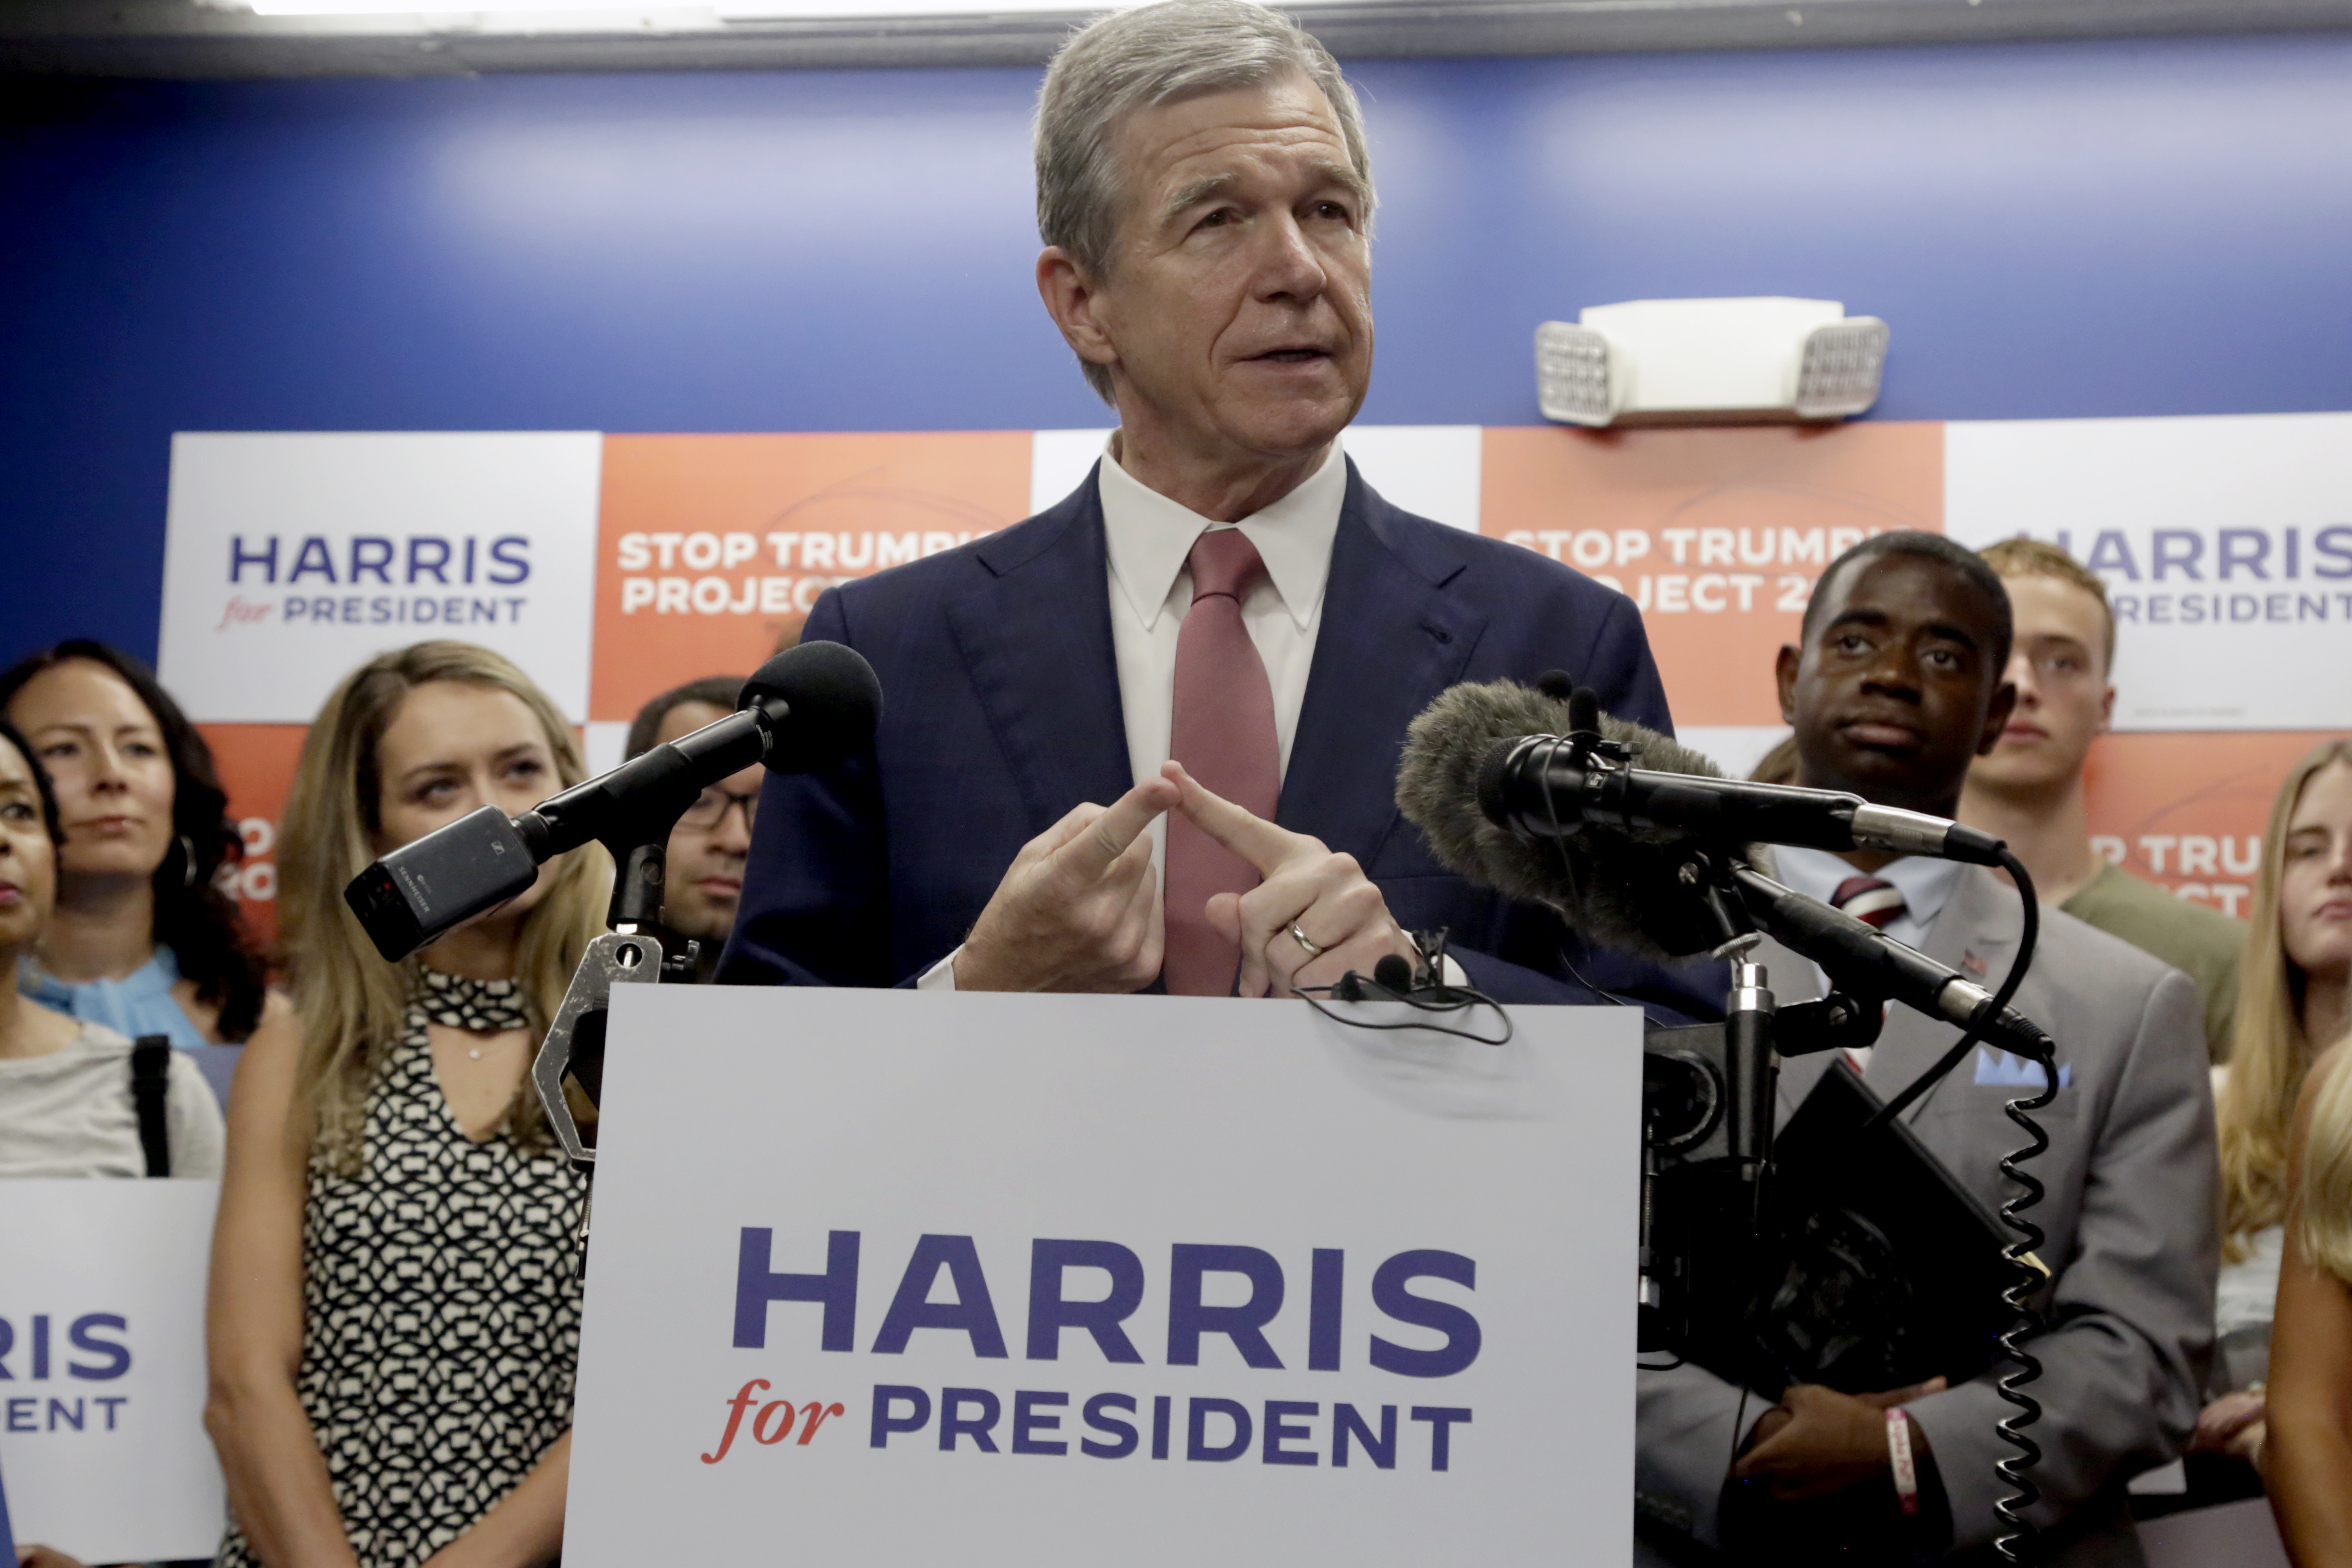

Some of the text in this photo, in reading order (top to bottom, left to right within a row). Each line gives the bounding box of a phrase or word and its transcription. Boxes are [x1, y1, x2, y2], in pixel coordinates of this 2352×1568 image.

[231, 536, 530, 584] HARRIS
[617, 530, 998, 570] STOP TRUMP'
[1662, 527, 1912, 565] TRUMP'
[2017, 527, 2352, 580] ARRIS
[214, 595, 526, 633] for PRESIDENT
[622, 575, 858, 615] PROJEC
[2114, 593, 2352, 623] RESIDENT
[731, 1226, 1483, 1378] HARRIS
[700, 1378, 1473, 1472] for PRESIDENT
